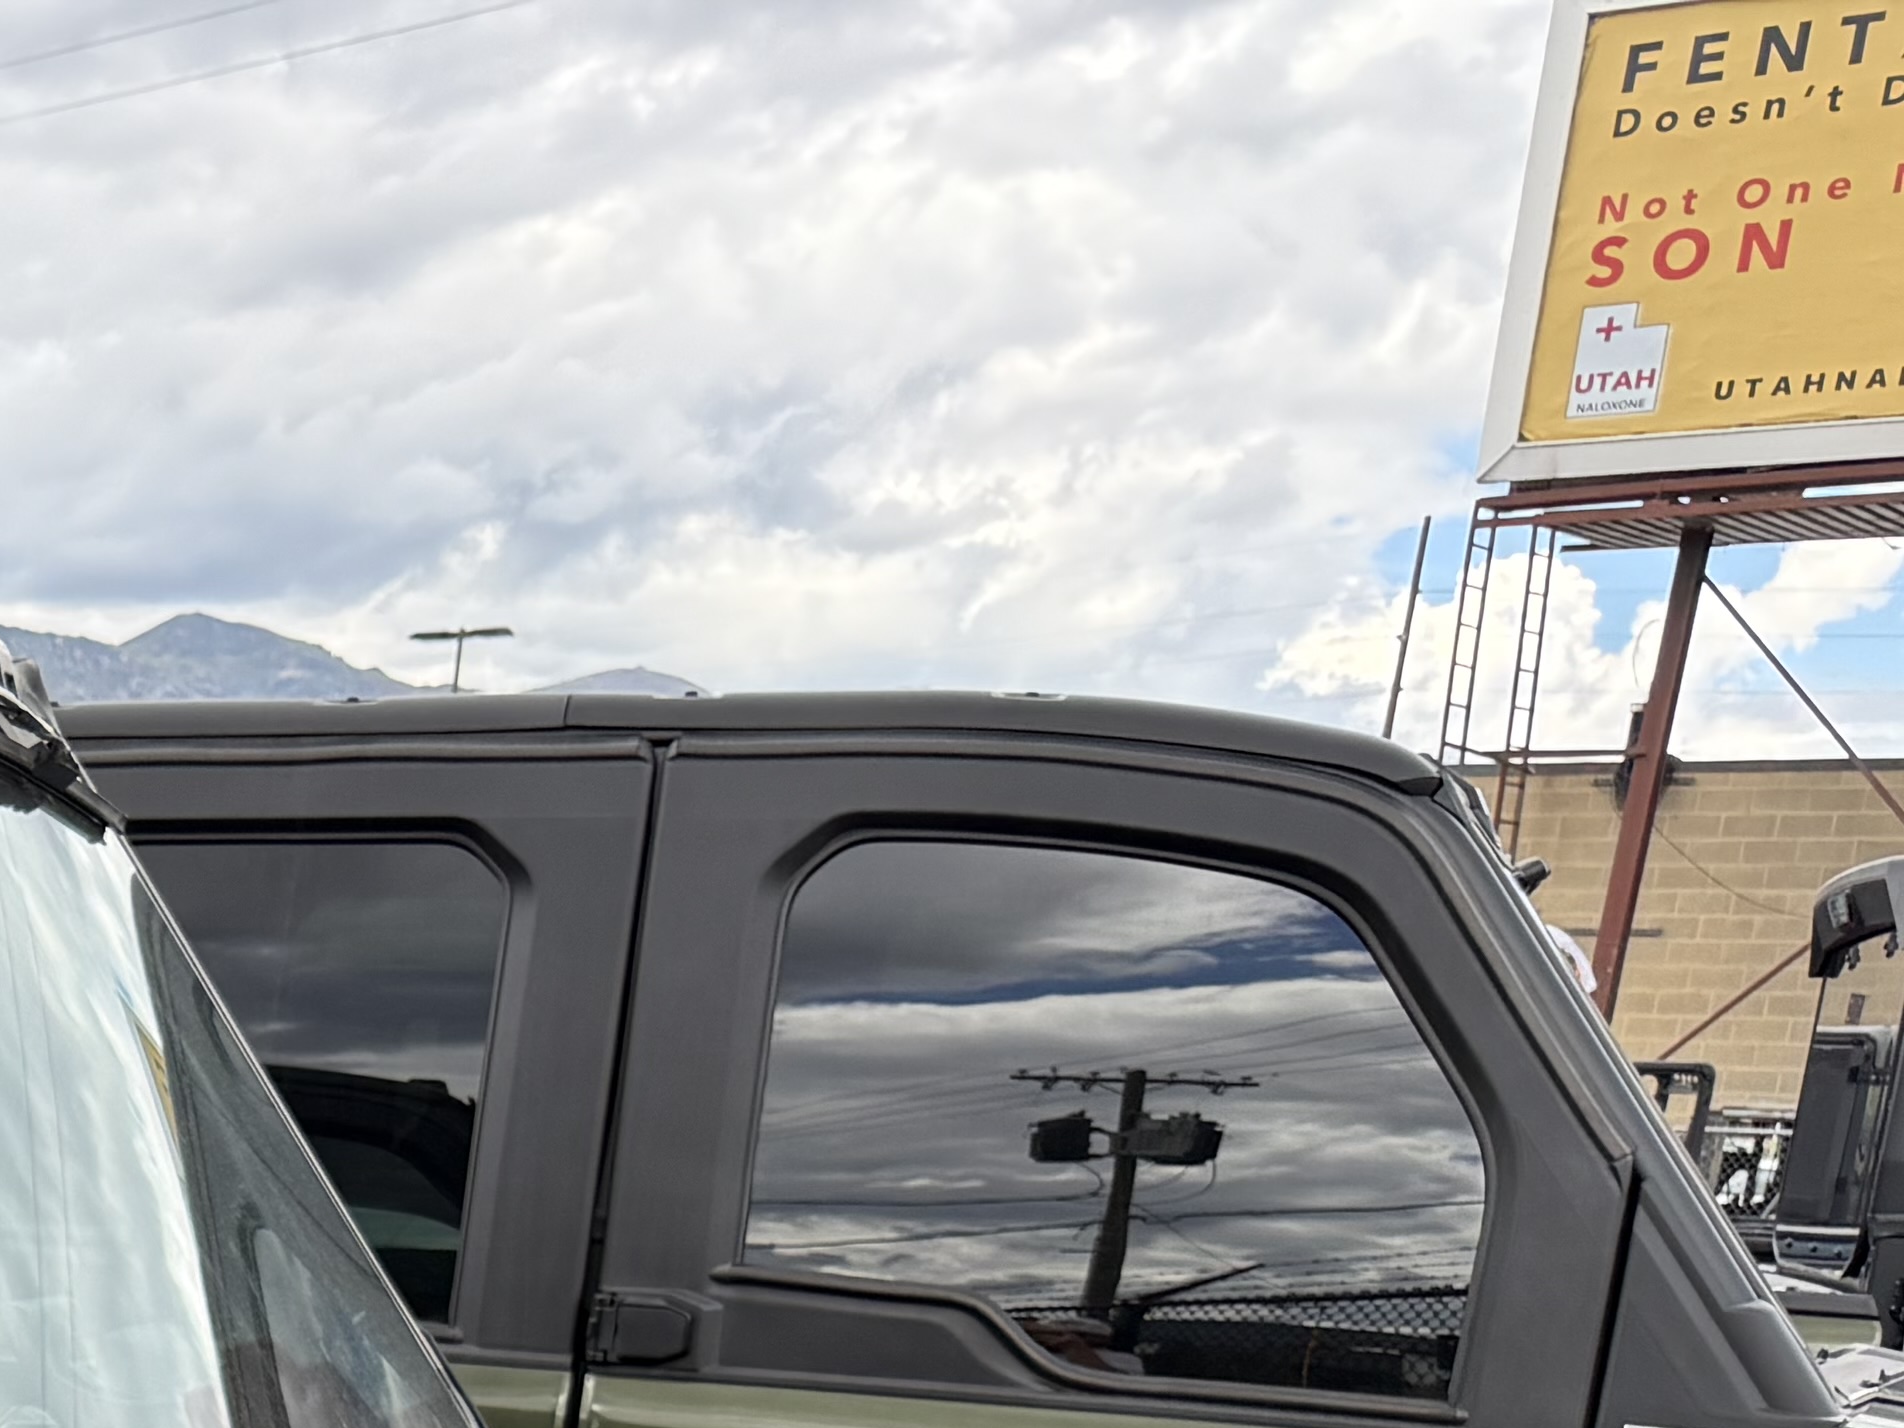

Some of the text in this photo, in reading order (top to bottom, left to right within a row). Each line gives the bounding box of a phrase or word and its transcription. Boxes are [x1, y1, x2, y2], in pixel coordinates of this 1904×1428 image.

[1621, 10, 1904, 93] FENT
[1612, 84, 1844, 138] Doesn't
[1598, 188, 1698, 225] Not
[1736, 177, 1852, 210] One
[1585, 218, 1794, 288] SON
[1574, 368, 1657, 394] UTAH
[1576, 397, 1647, 413] NALOXONE
